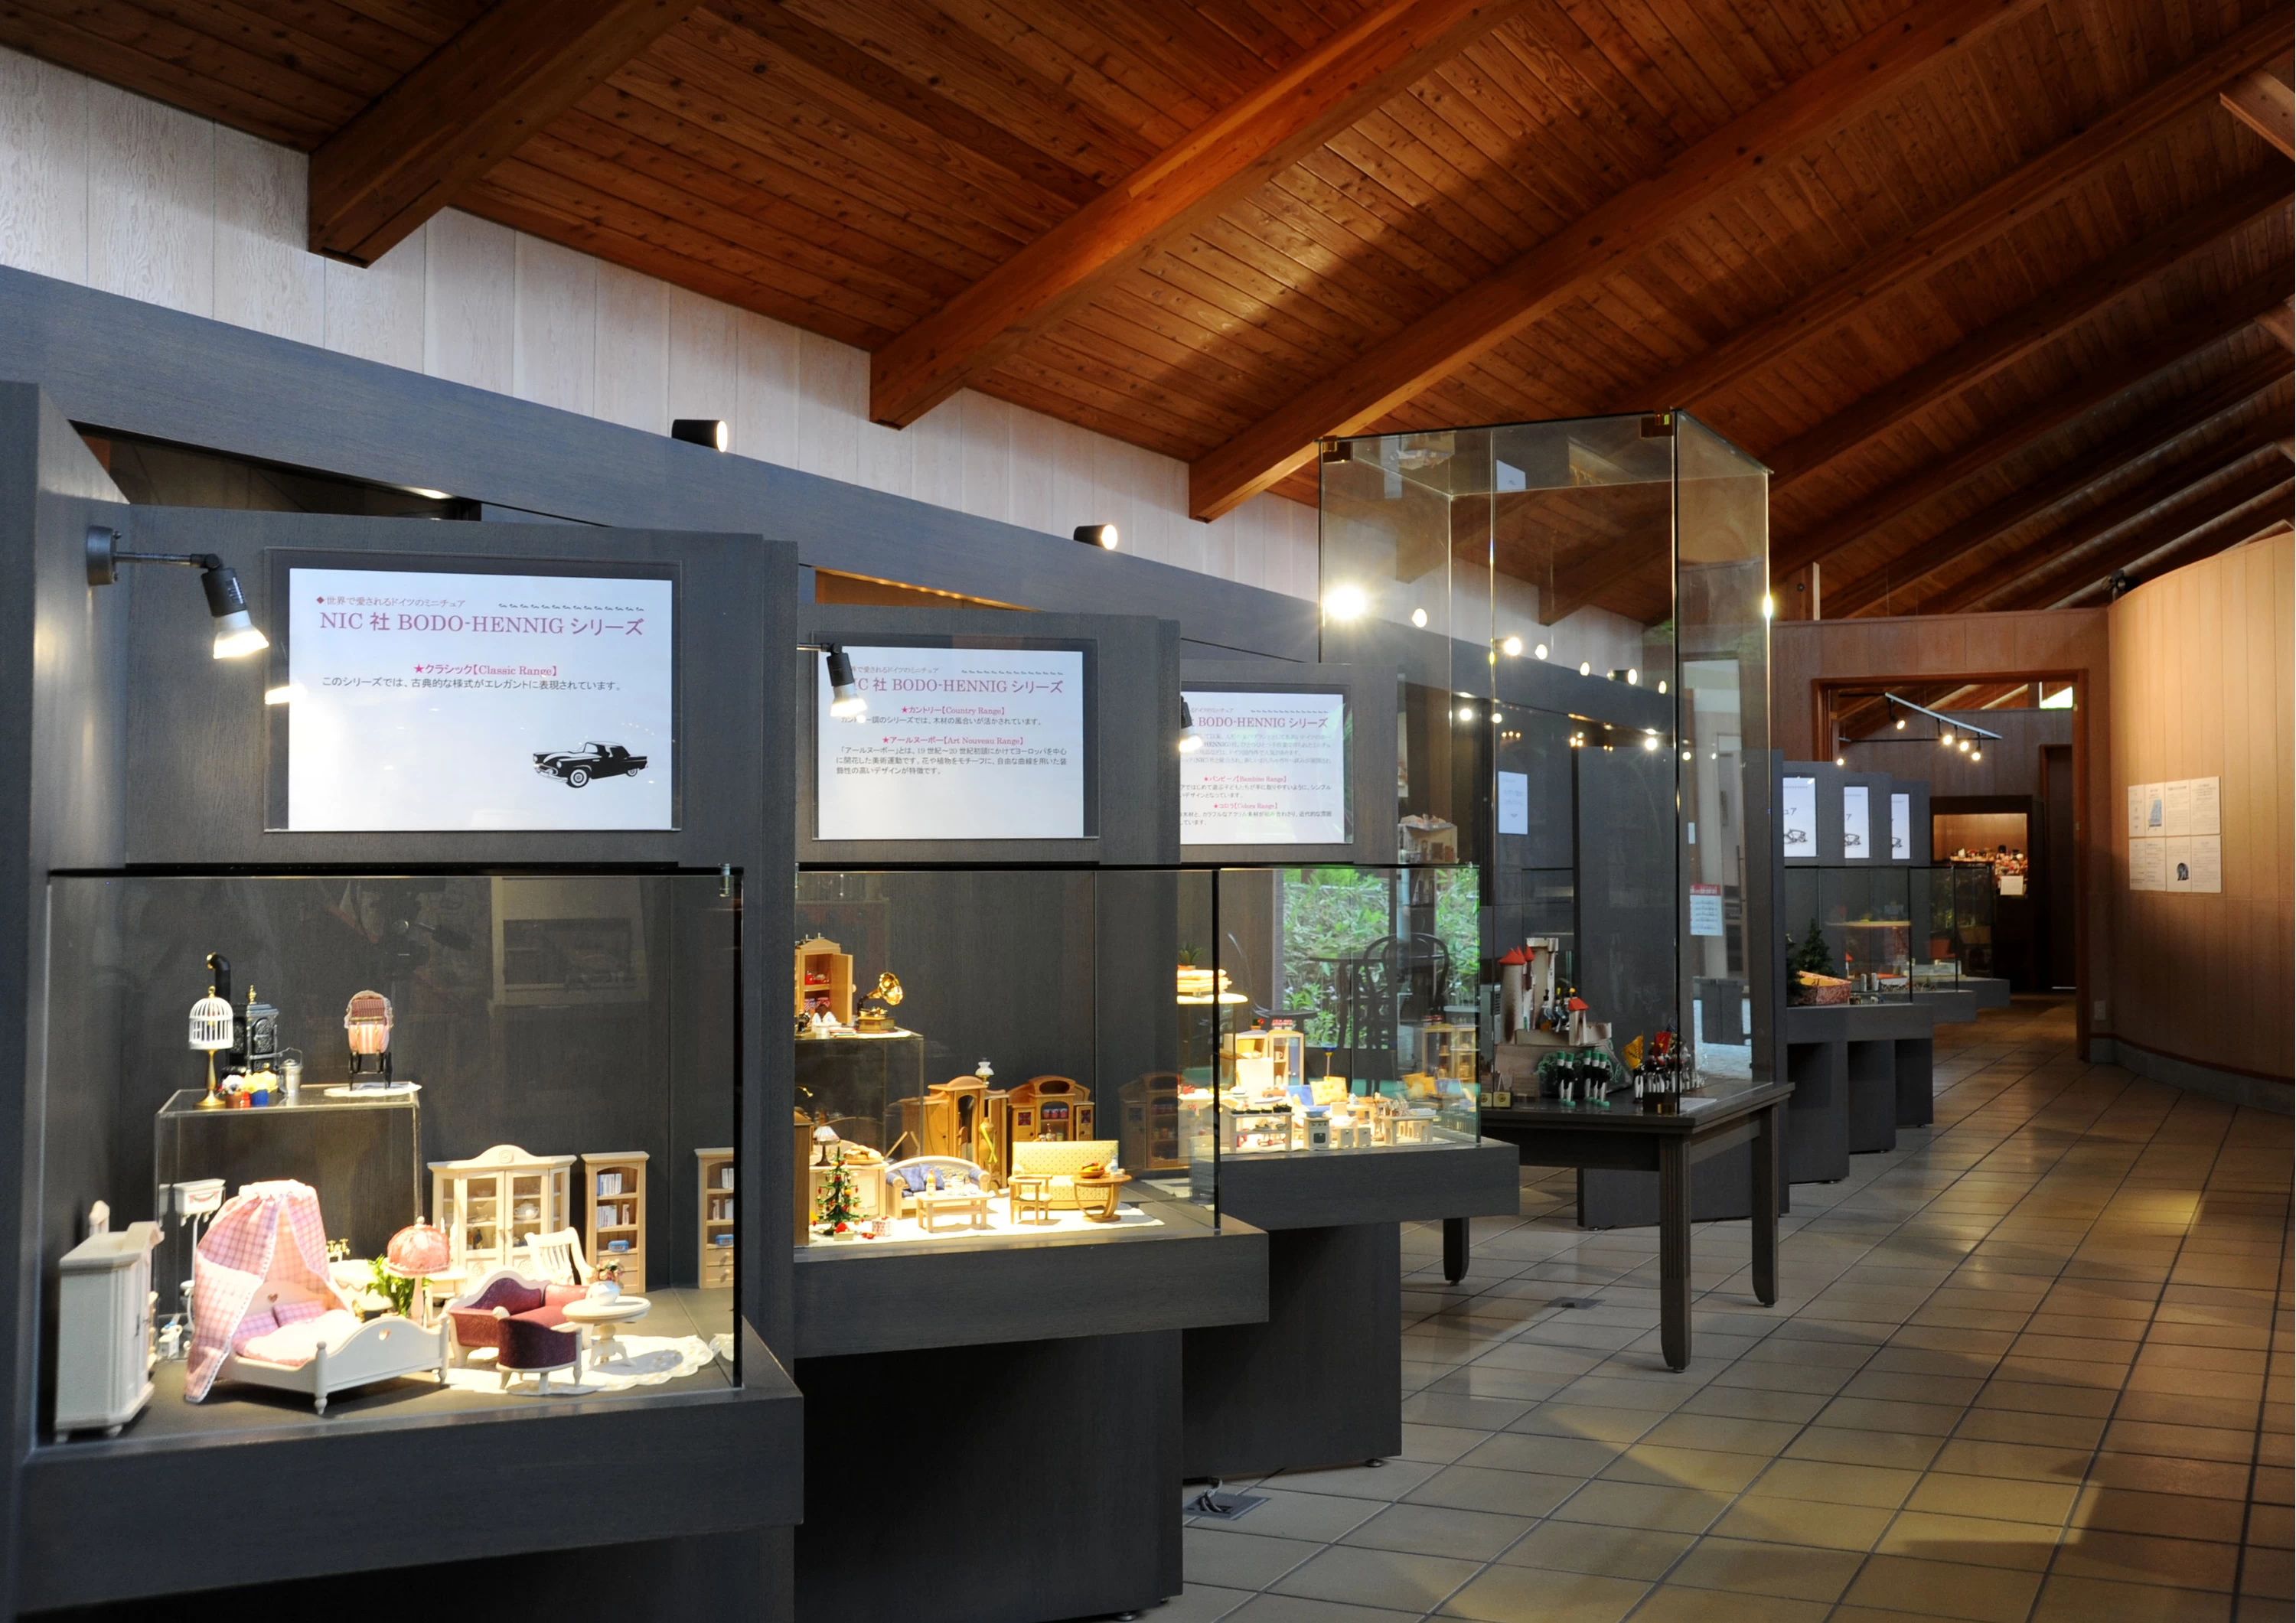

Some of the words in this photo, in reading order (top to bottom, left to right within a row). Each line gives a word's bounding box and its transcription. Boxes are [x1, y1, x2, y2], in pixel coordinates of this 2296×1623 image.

[320, 612, 363, 629] NIC
[370, 612, 390, 631] 社
[397, 614, 564, 634] BODO-HENNIG
[571, 618, 644, 636] シリーズ
[322, 677, 621, 690] このシリーズでは、古典的な様式がエレガントに表現されています。
[872, 677, 887, 692] 社
[892, 679, 1006, 693] BODO-HENNIG
[1012, 680, 1063, 694] シリーズ
[841, 716, 1042, 725] カントー調のシリーズでは、木材の風合いが活かされています。
[1199, 716, 1286, 728] BODO-HENNIG
[1289, 717, 1328, 728] シリーズ
